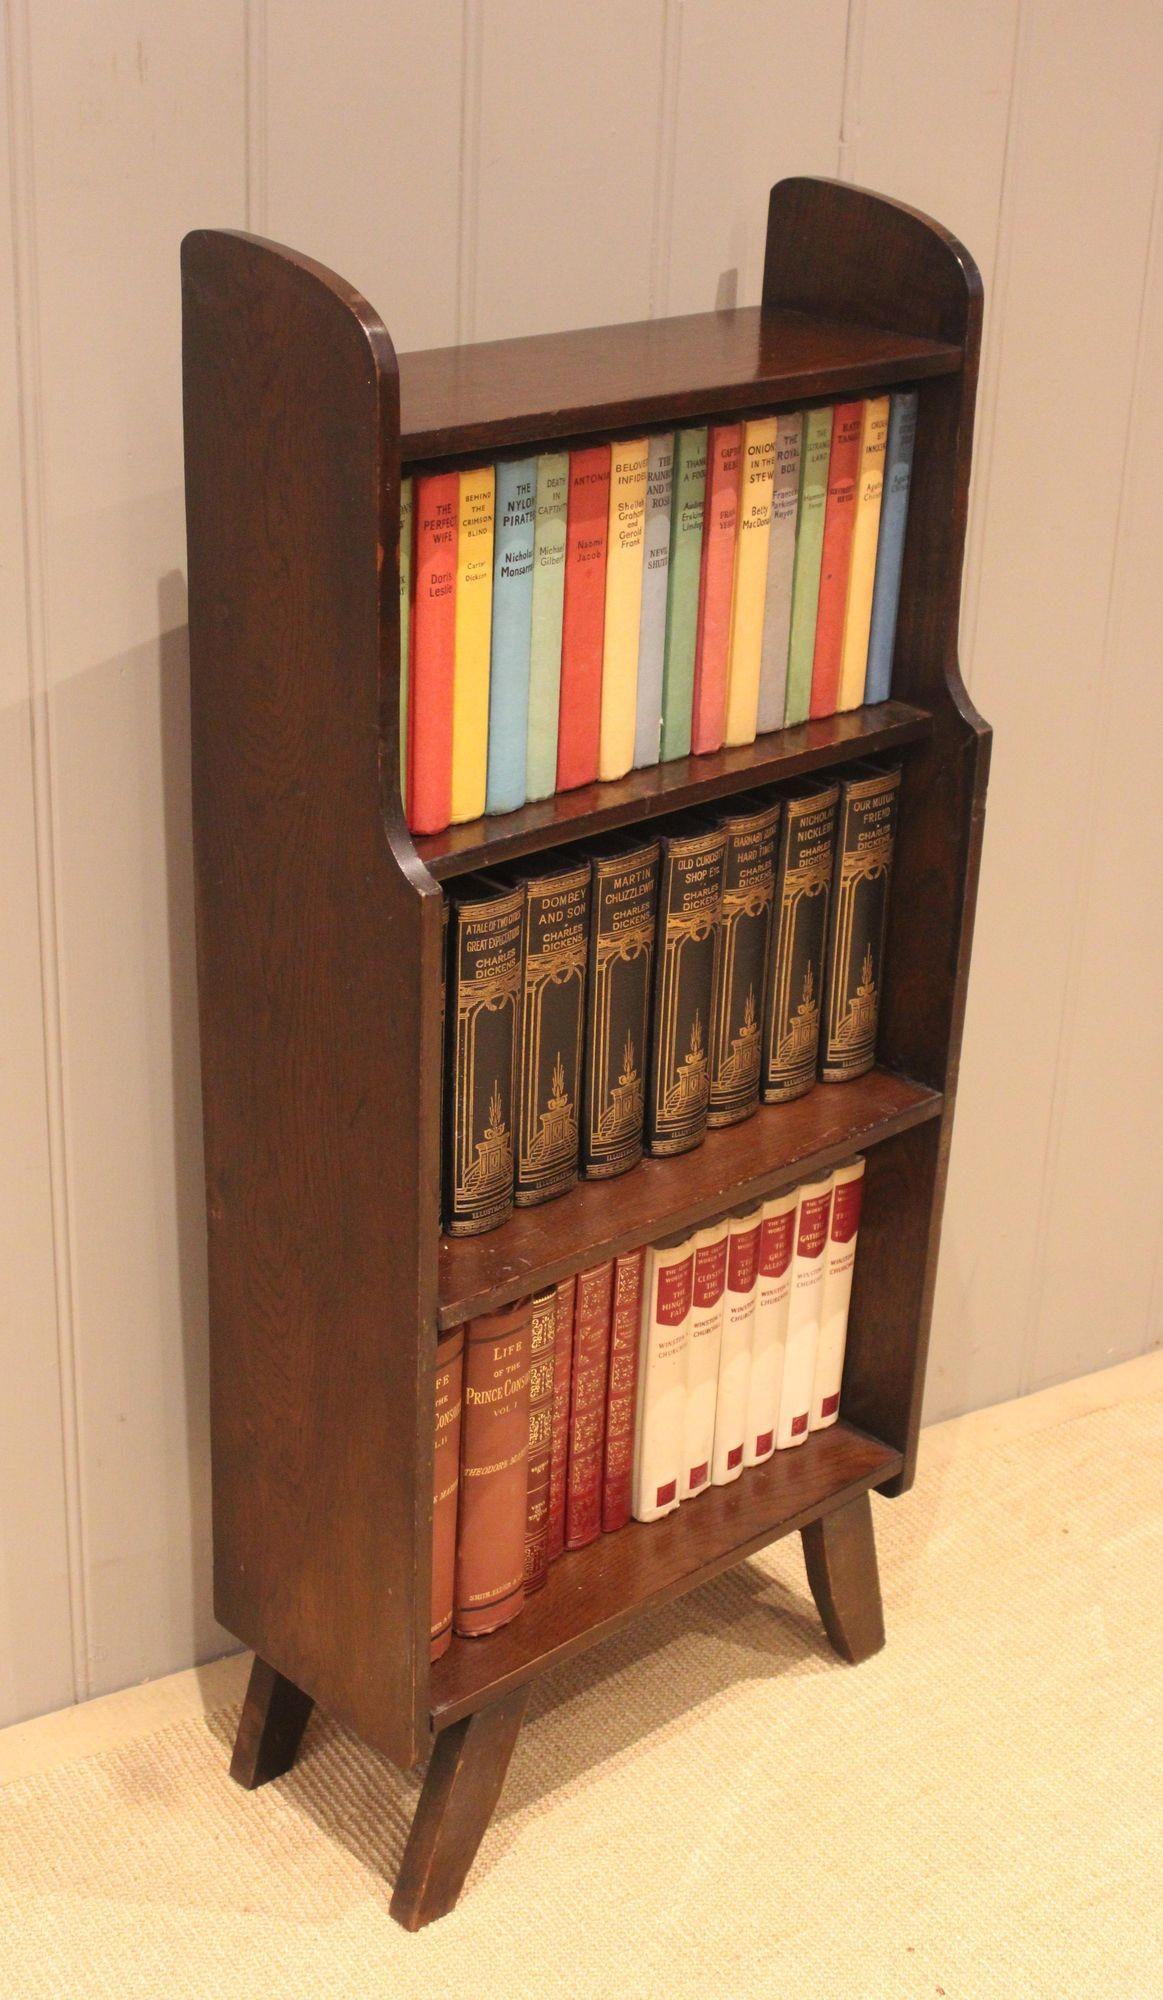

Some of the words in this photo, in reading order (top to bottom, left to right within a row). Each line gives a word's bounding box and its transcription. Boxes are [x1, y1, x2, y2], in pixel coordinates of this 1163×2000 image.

[784, 435, 798, 445] THE
[751, 460, 760, 469] IN
[762, 457, 774, 466] THE
[781, 464, 796, 475] BOX
[684, 474, 690, 482] A
[750, 470, 774, 484] STEW
[465, 491, 491, 502] BEHIND
[516, 483, 531, 496] THE
[552, 492, 560, 500] IN
[648, 485, 664, 495] AND
[436, 503, 452, 516] THE
[463, 515, 493, 527] CRIMSON
[628, 521, 638, 529] and
[433, 531, 452, 544] WIFE
[467, 528, 487, 538] BLIND
[577, 540, 603, 549] Naomi
[621, 539, 640, 549] Frank
[577, 551, 601, 562] Jacob
[431, 573, 453, 585] Doris
[853, 801, 871, 812] OUR
[738, 849, 757, 863] HARD
[799, 840, 832, 858] CHARLES
[678, 859, 693, 871] OLD
[740, 860, 772, 878] CHARLES
[613, 867, 651, 890] MARTIN
[685, 870, 708, 884] SHOP
[738, 869, 773, 888] DICKENS
[605, 880, 654, 905] CHUZZLEWIT
[683, 882, 719, 901] CHARLES
[542, 888, 586, 910] DOMBEY
[682, 892, 719, 911] DICKENS
[538, 911, 563, 925] AND
[567, 903, 586, 919] SON
[613, 902, 650, 921] CHARLES
[466, 925, 472, 935] A
[473, 919, 488, 934] TALE
[612, 911, 650, 931] DICKENS
[542, 923, 583, 942] CHARLES
[466, 938, 488, 952] GREAT
[542, 933, 583, 953] DICKENS
[475, 948, 516, 969] CHARLES
[475, 958, 516, 979] DICKENS
[493, 1341, 523, 1361] LIFE
[494, 1368, 503, 1378] OF
[506, 1362, 521, 1374] THE
[435, 1374, 449, 1389] FE
[466, 1386, 502, 1405] PRINCE
